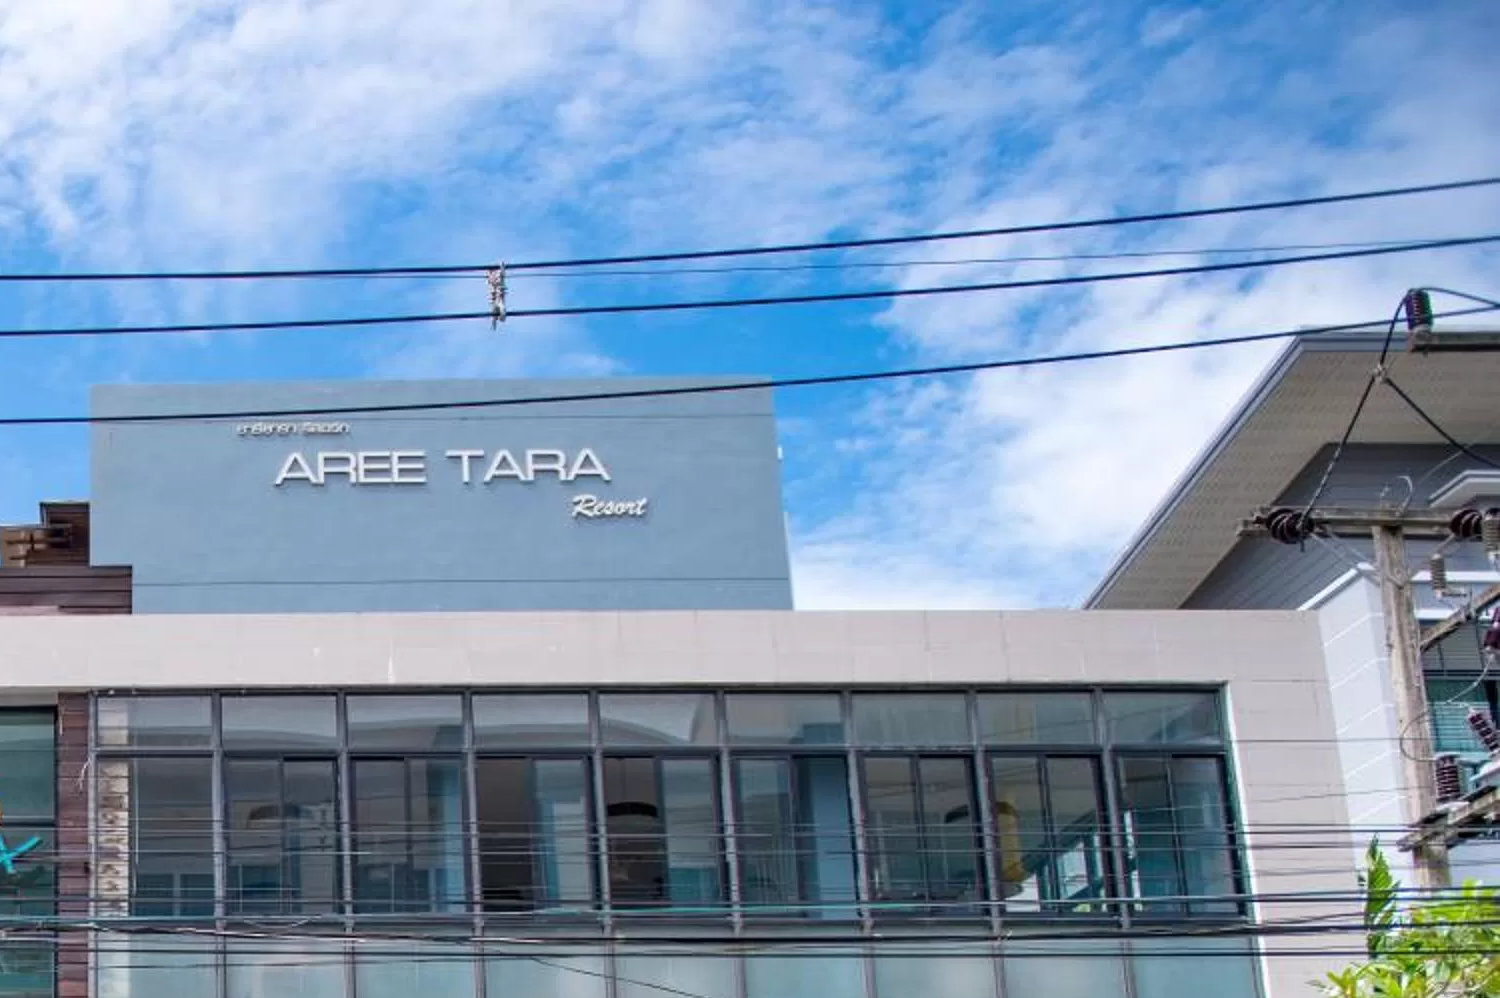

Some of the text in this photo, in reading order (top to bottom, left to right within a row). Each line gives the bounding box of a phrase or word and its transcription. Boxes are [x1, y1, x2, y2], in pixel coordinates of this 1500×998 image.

[274, 448, 612, 485] AREE TARA
[571, 494, 648, 518] Resort
